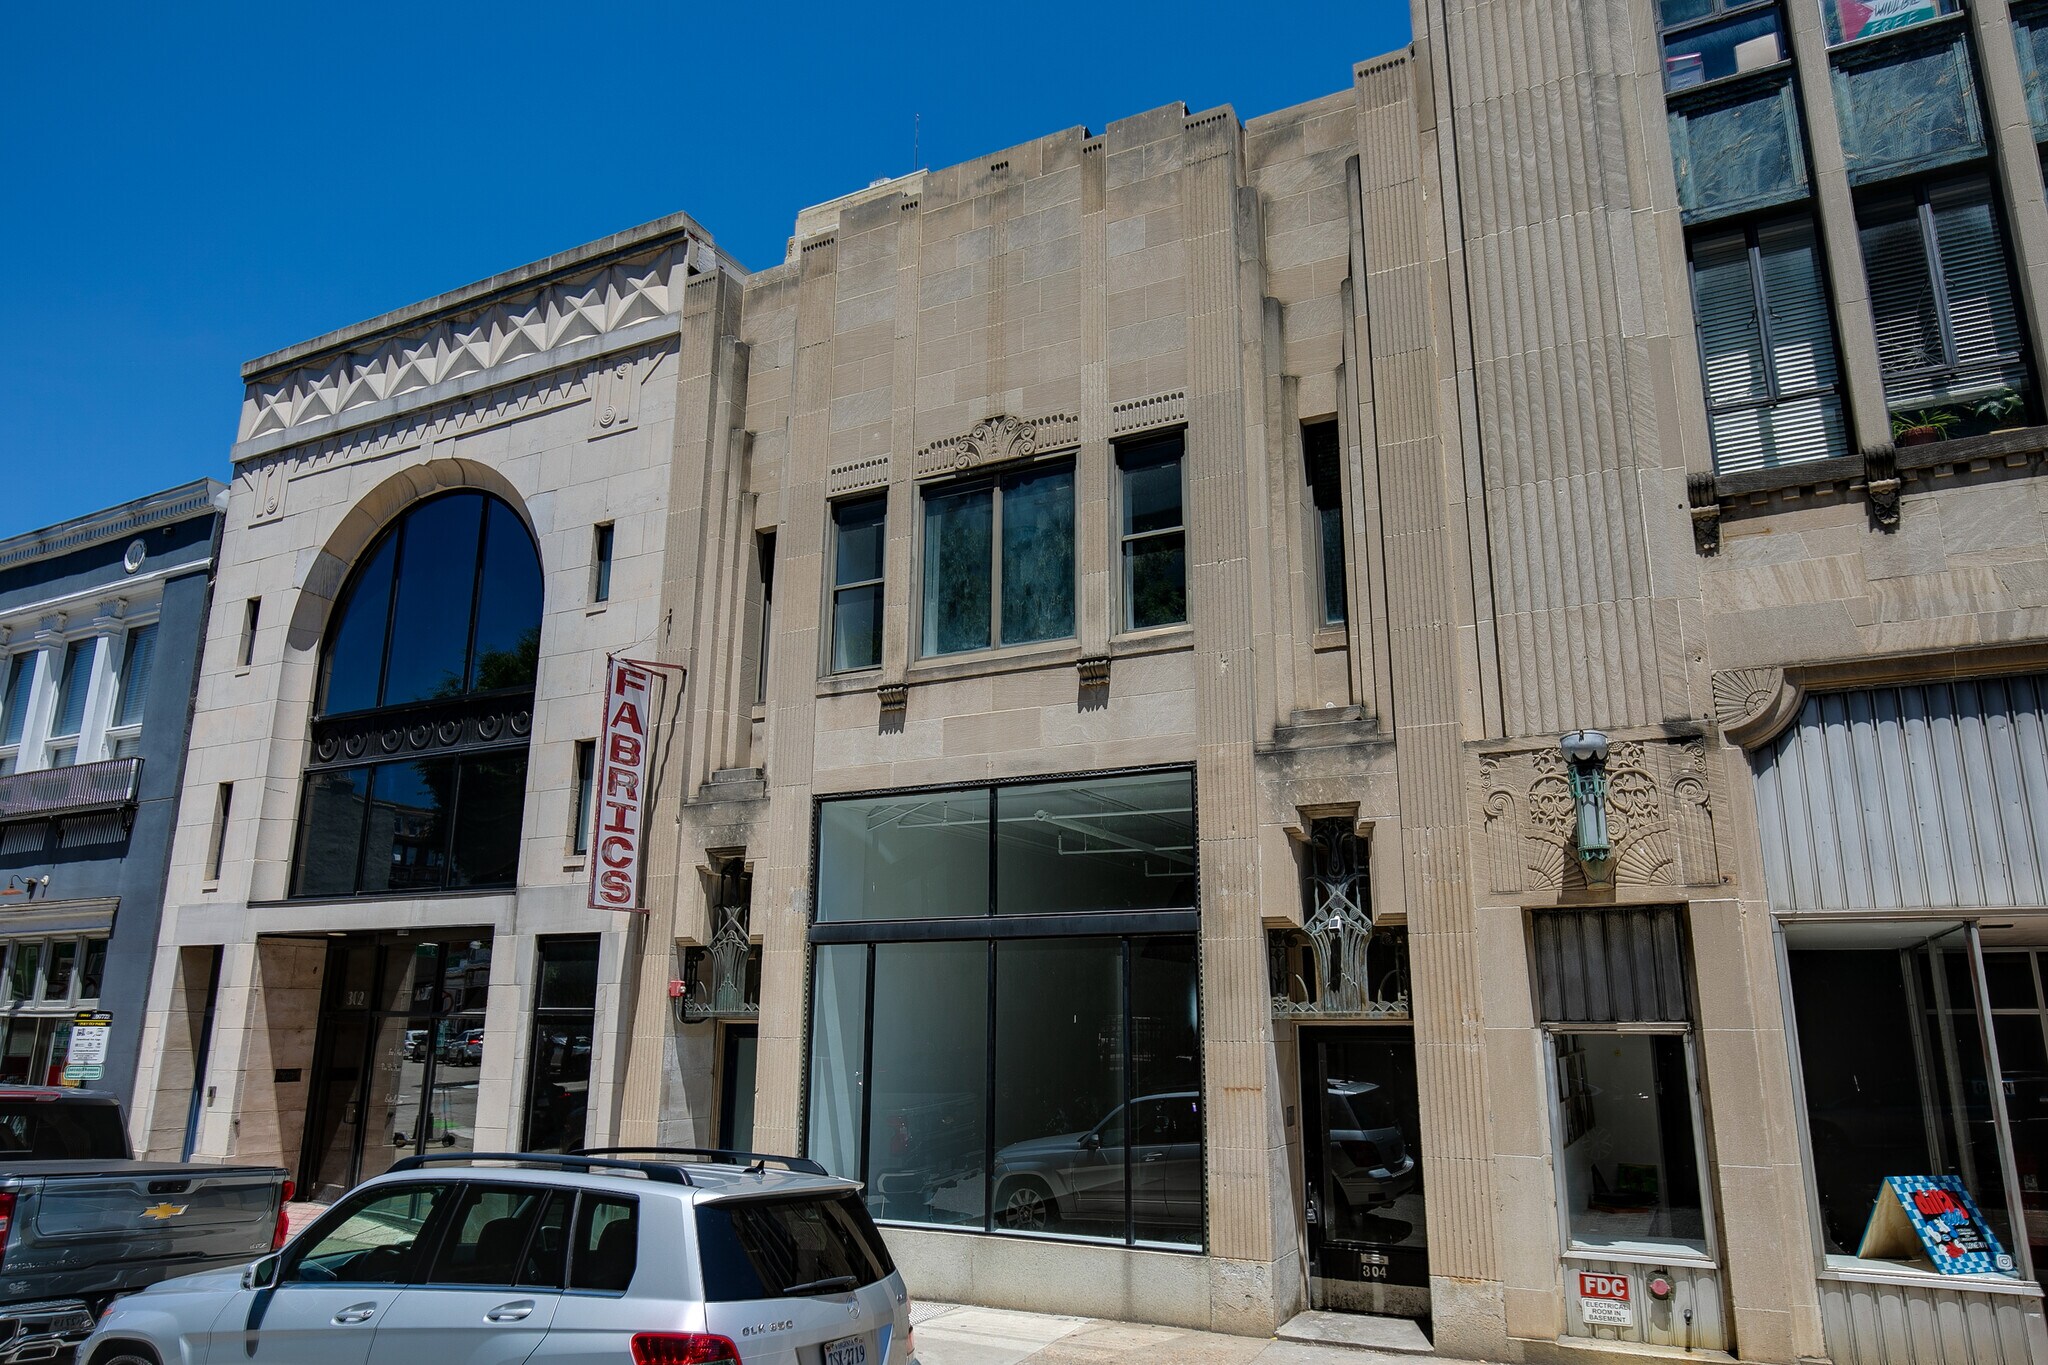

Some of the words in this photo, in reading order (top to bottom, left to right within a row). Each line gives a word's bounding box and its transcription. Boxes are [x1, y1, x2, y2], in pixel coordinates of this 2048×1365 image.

[1870, 11, 1920, 33] FREE
[599, 665, 647, 905] FABRICS
[346, 991, 365, 1006] 302
[1362, 1264, 1387, 1279] 304
[1585, 1277, 1625, 1297] FDC
[1585, 1301, 1629, 1310] ELECTRICAL
[1589, 1314, 1626, 1322] BASEMENT
[741, 1323, 766, 1336] GLK
[768, 1319, 793, 1332] 350
[828, 1345, 865, 1365] TSX-2719
